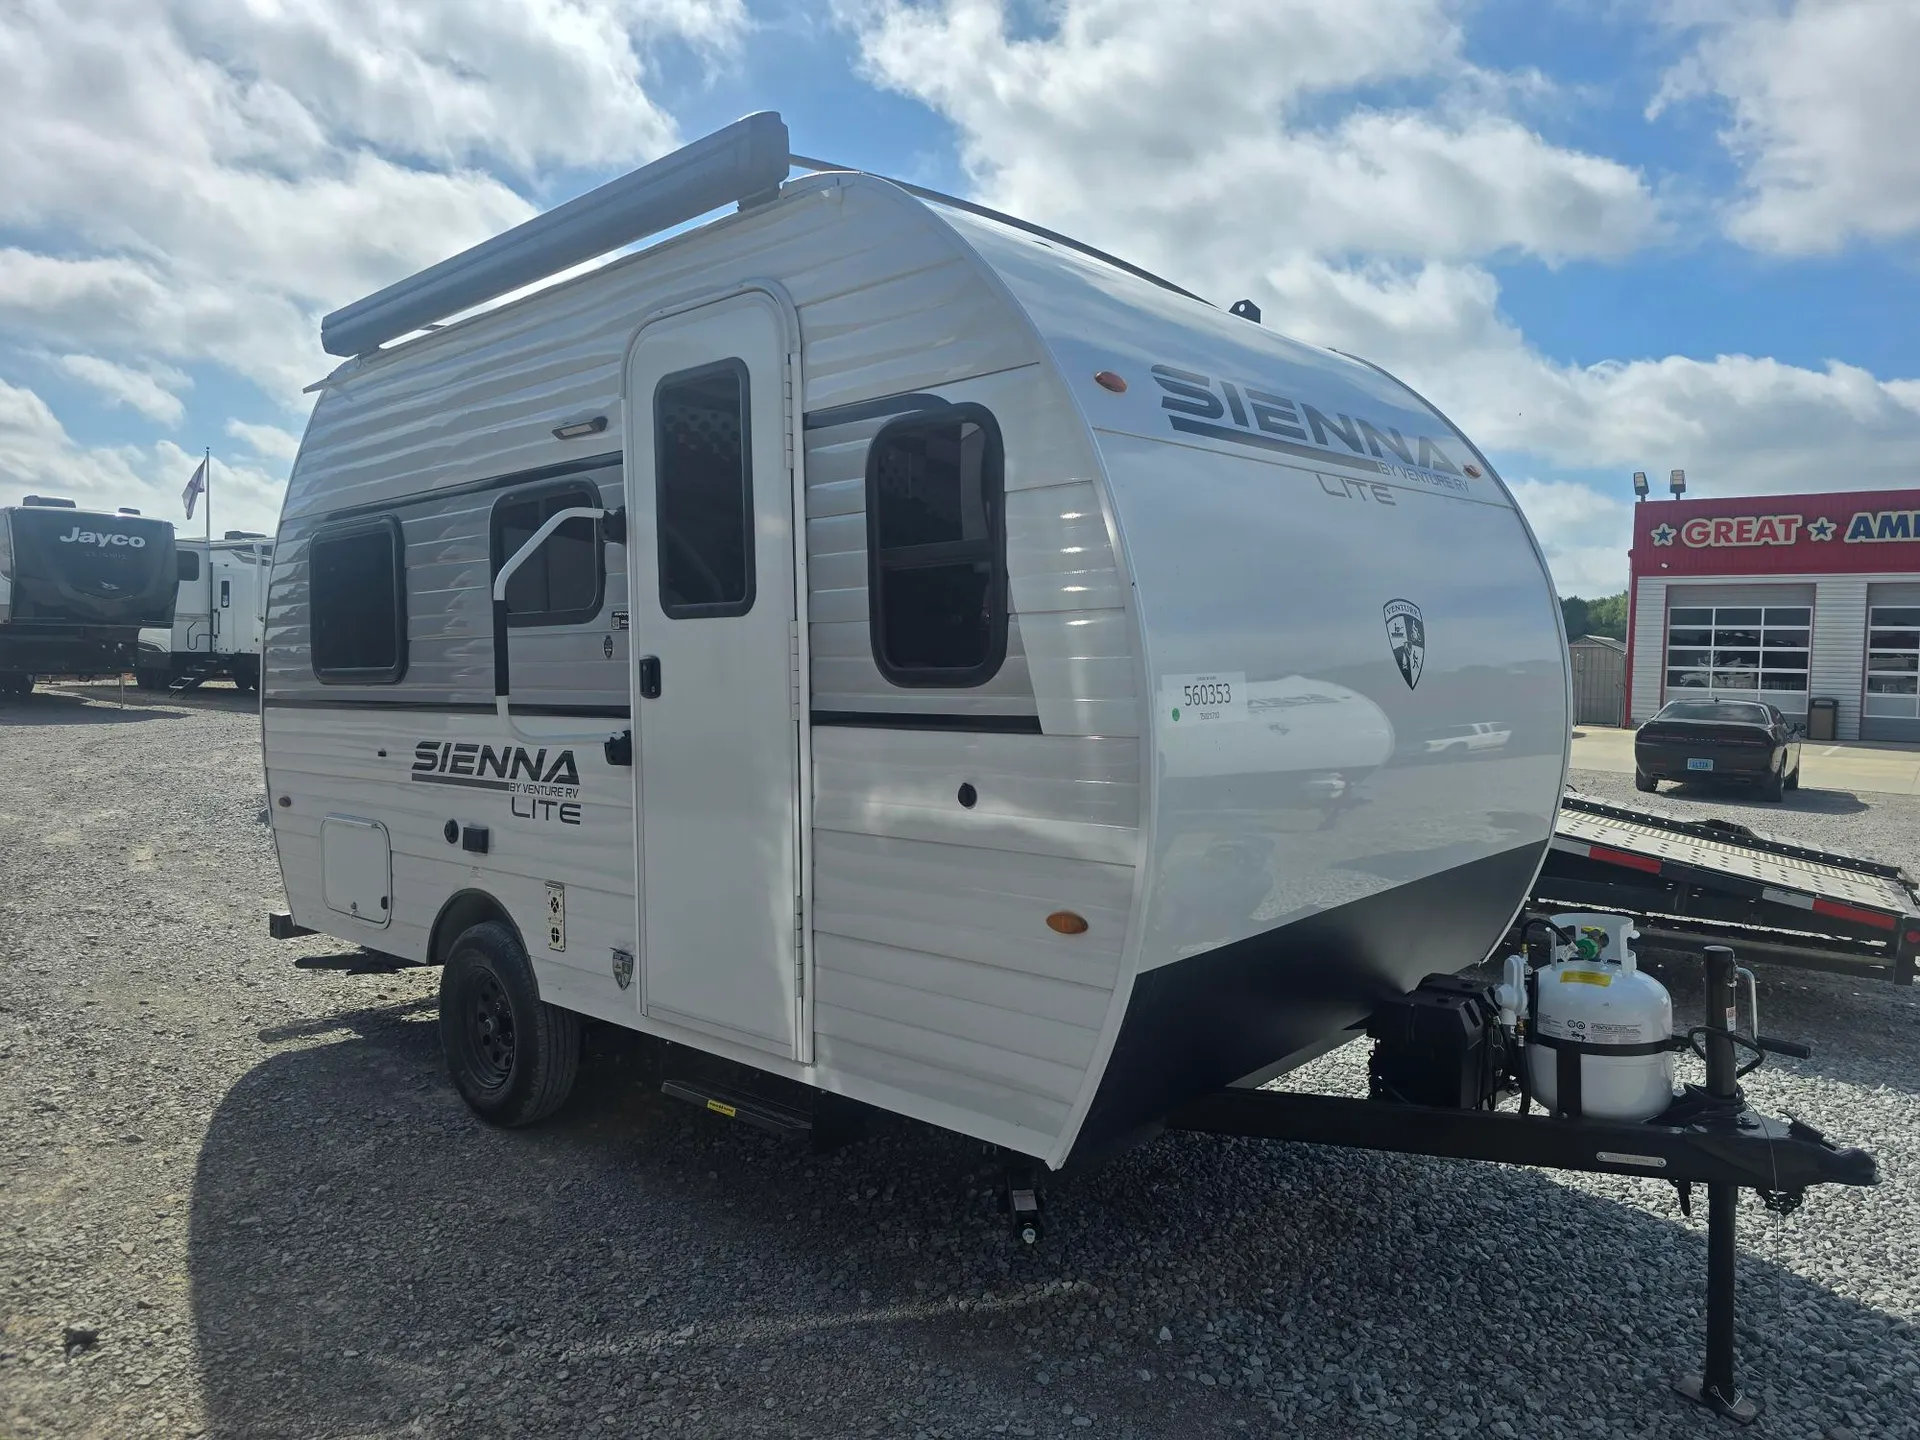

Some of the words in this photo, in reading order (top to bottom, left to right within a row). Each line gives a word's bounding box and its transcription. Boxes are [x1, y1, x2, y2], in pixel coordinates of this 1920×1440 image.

[1151, 364, 1464, 476] SIENNA
[1316, 473, 1397, 506] LITE
[1379, 461, 1397, 477] BY
[1399, 466, 1455, 490] VENTURE
[1455, 479, 1469, 493] RV
[59, 526, 146, 548] Jayco
[1684, 516, 1800, 546] GREAT
[1386, 604, 1420, 617] VENTURE
[1184, 683, 1232, 706] 560353
[411, 740, 580, 785] SIENNA
[509, 782, 521, 793] BY
[523, 783, 563, 798] VENTURE
[565, 787, 579, 799] RV
[511, 796, 581, 825] LITE
